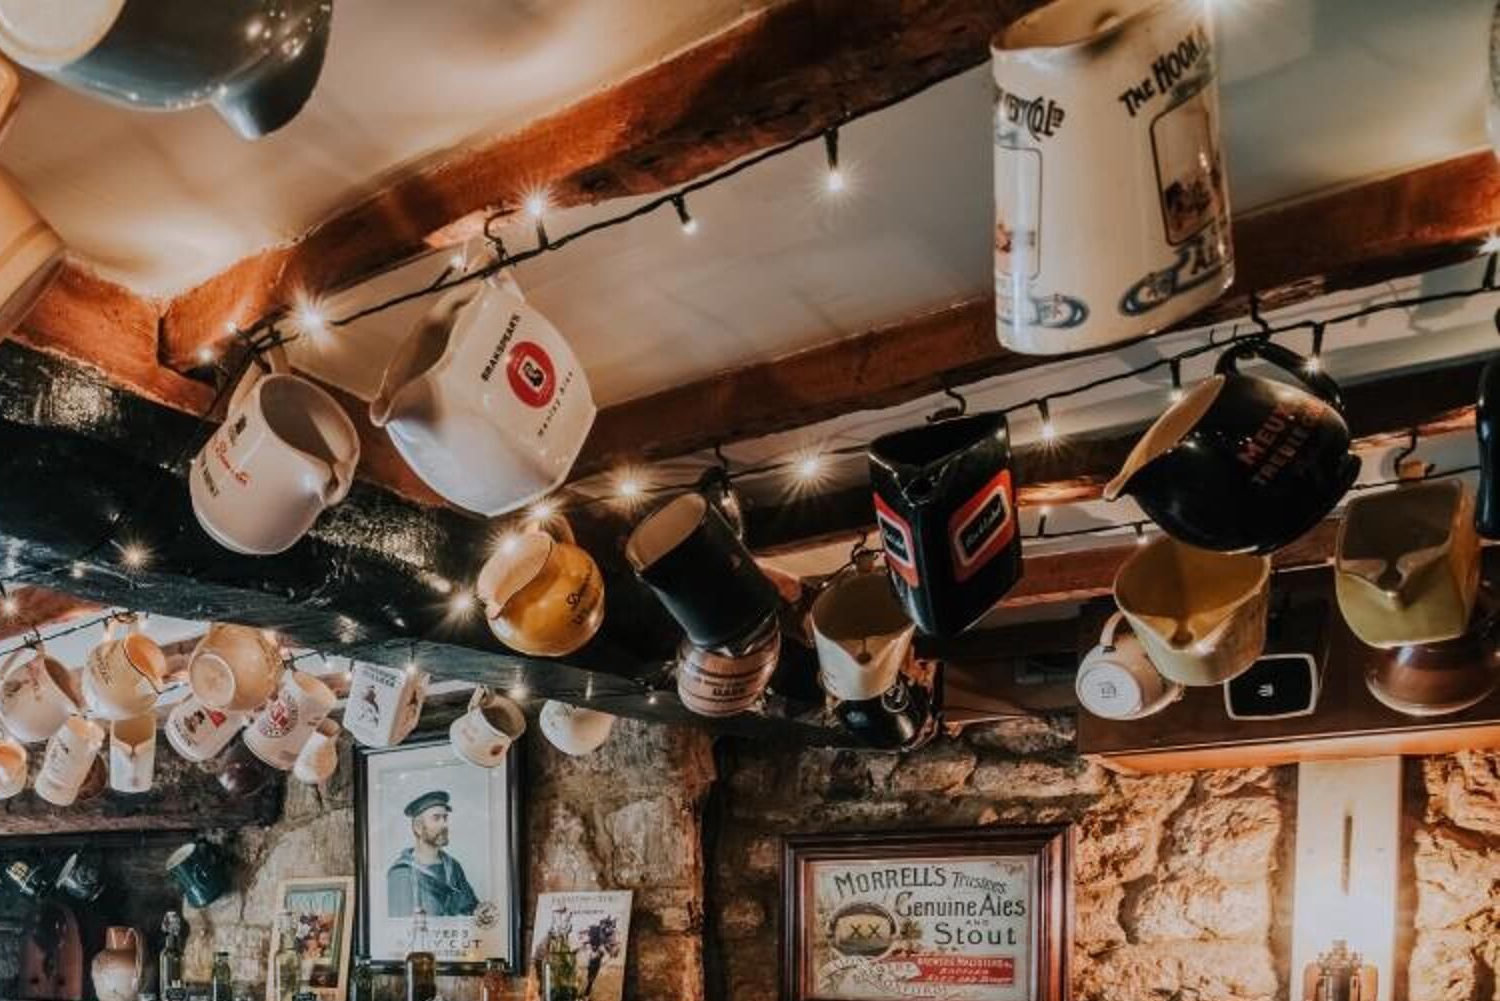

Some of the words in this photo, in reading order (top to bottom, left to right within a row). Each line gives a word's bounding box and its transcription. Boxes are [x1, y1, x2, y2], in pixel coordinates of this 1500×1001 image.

[1118, 78, 1156, 117] THE
[833, 865, 947, 899] MORRELL'S
[894, 891, 981, 918] Genuine
[979, 891, 1027, 918] Ales
[933, 922, 1018, 946] Stout
